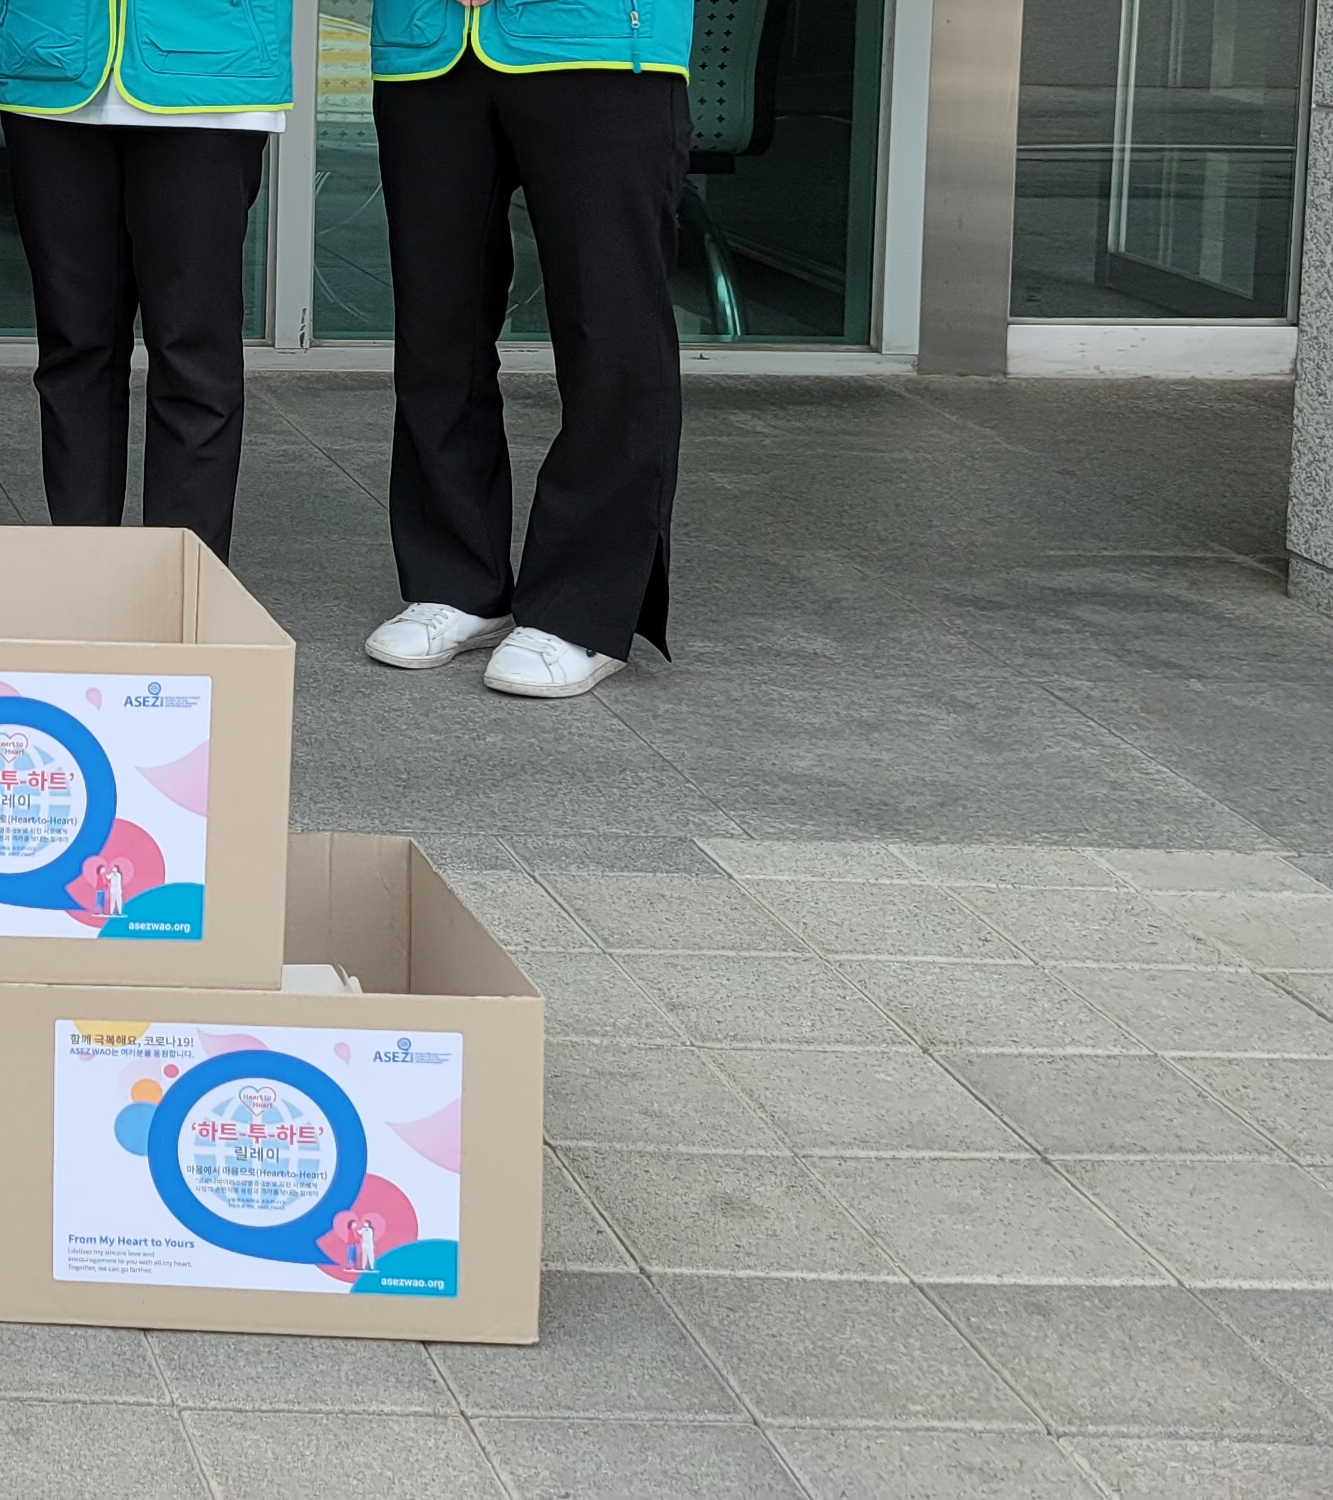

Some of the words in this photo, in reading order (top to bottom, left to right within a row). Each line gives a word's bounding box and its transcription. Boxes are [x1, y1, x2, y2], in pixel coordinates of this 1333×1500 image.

[127, 921, 190, 933] asezwao.org
[70, 1032, 91, 1044] 함께
[143, 1035, 193, 1048] 코로나19!
[234, 1146, 279, 1163] 릴레이
[68, 1234, 96, 1244] From
[99, 1235, 115, 1247] My
[117, 1236, 148, 1246] Heart
[151, 1238, 162, 1247] to
[164, 1238, 194, 1248] Yours
[380, 1277, 445, 1290] asezwao.org
